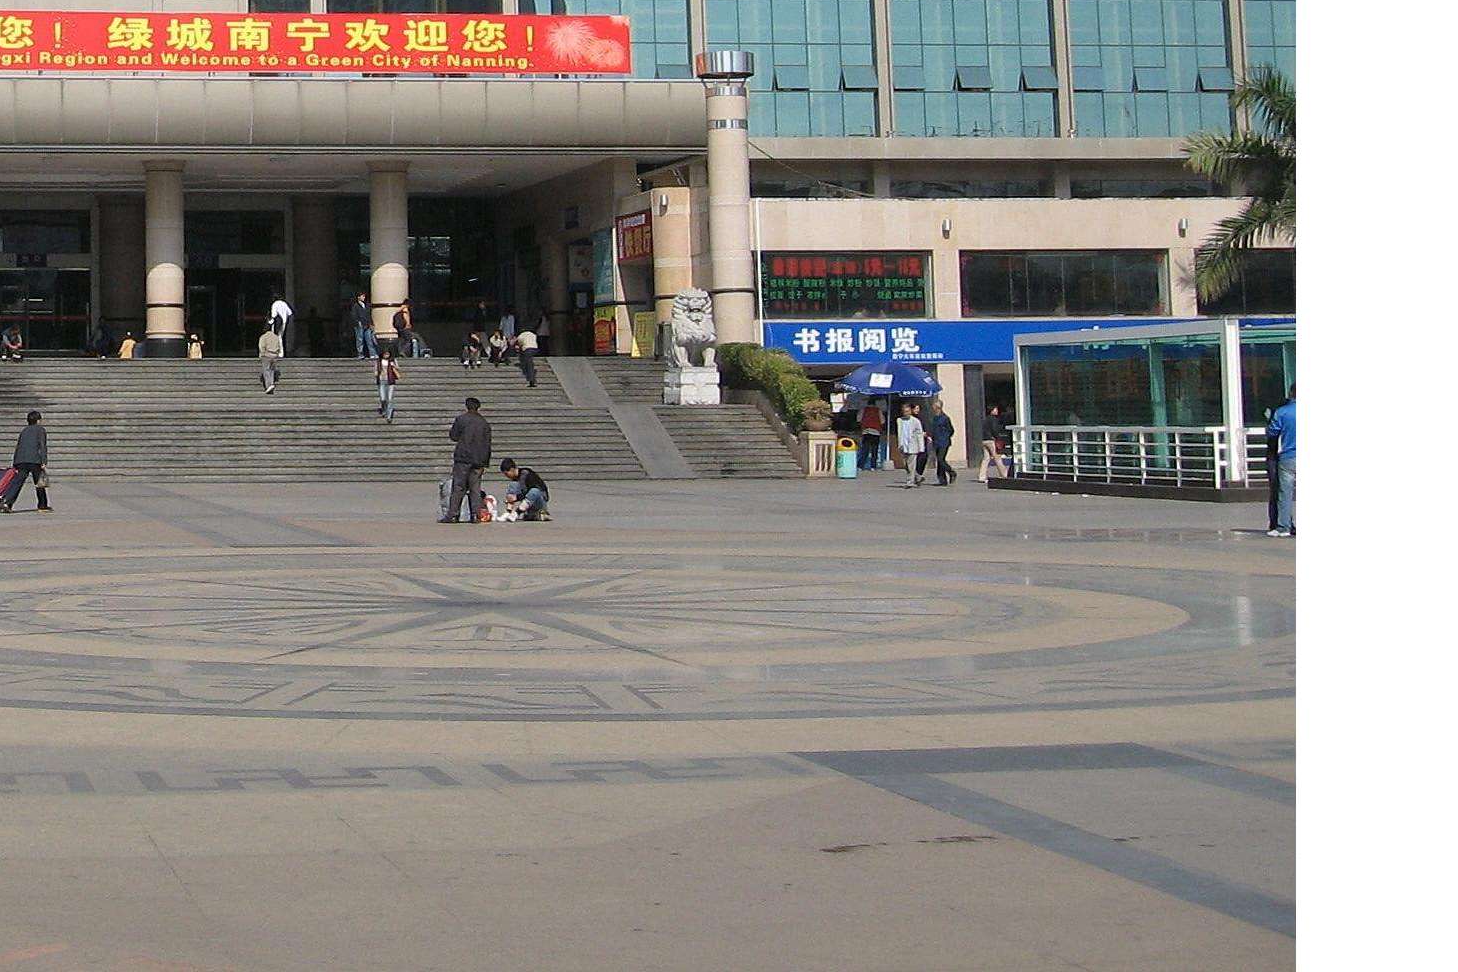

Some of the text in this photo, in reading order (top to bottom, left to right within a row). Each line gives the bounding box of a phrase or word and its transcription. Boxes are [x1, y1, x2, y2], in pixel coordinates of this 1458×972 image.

[39, 51, 108, 67] Region
[117, 52, 152, 65] and
[161, 52, 251, 66] Welcome
[258, 53, 279, 66] to
[286, 56, 298, 66] a
[305, 53, 364, 67] Green
[371, 54, 411, 69] City
[420, 54, 440, 67] of
[446, 54, 535, 69] Nanning.
[792, 327, 920, 354] 书报阅览
